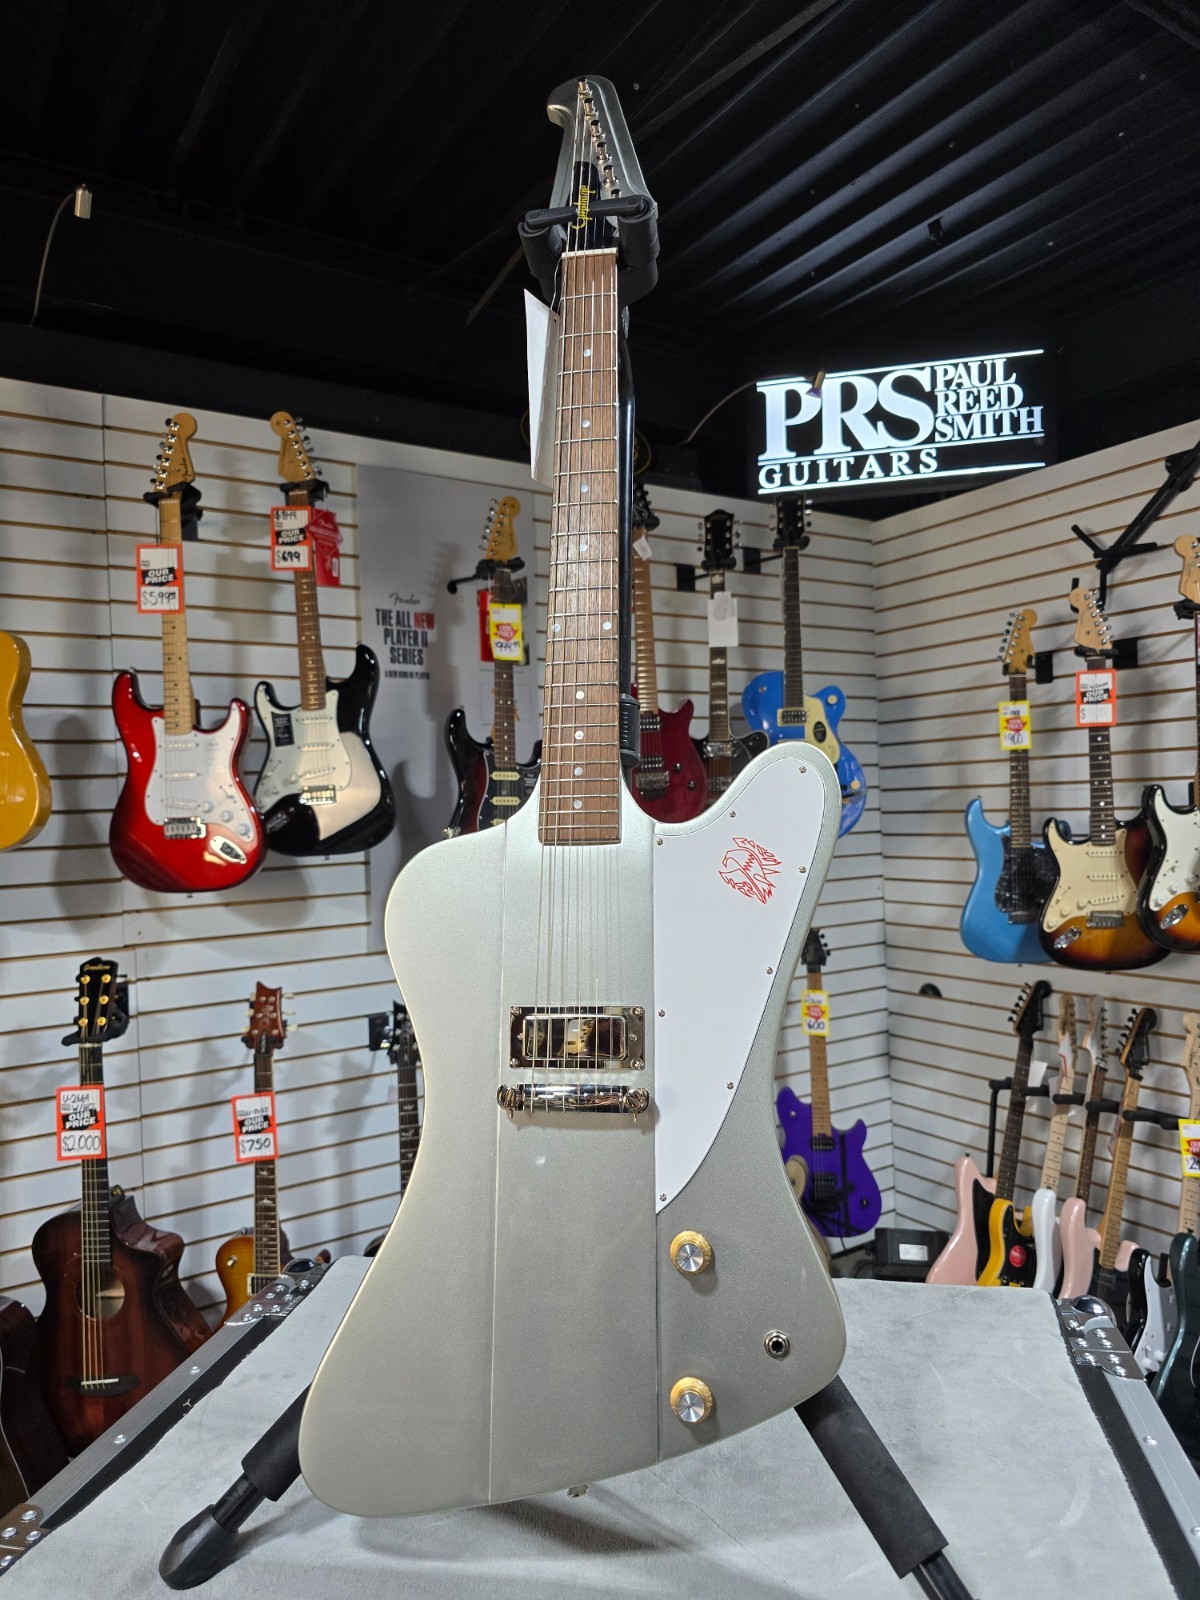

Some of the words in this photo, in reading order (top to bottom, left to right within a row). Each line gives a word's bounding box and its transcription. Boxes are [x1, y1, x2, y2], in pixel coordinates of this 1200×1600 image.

[934, 358, 1017, 392] PAUL
[934, 383, 1024, 417] REED
[756, 366, 935, 460] PRS
[934, 405, 1044, 443] SMITH
[758, 448, 938, 489] GUITARS
[278, 534, 305, 544] PRICE
[280, 529, 300, 538] OUR
[276, 550, 301, 564] $699
[145, 574, 174, 584] PRICE
[148, 568, 169, 578] OUR
[375, 608, 394, 627] THE
[395, 610, 412, 629] ALL
[413, 611, 435, 631] NEW
[384, 628, 420, 647] PLAYER
[389, 646, 424, 666] SERIES
[1083, 693, 1109, 703] PRICE
[1086, 689, 1104, 698] OUR
[68, 1110, 91, 1121] OUR
[244, 1115, 264, 1126] OUR
[65, 1116, 96, 1129] PRICE
[242, 1121, 269, 1134] PRICE
[240, 1137, 271, 1154] $750
